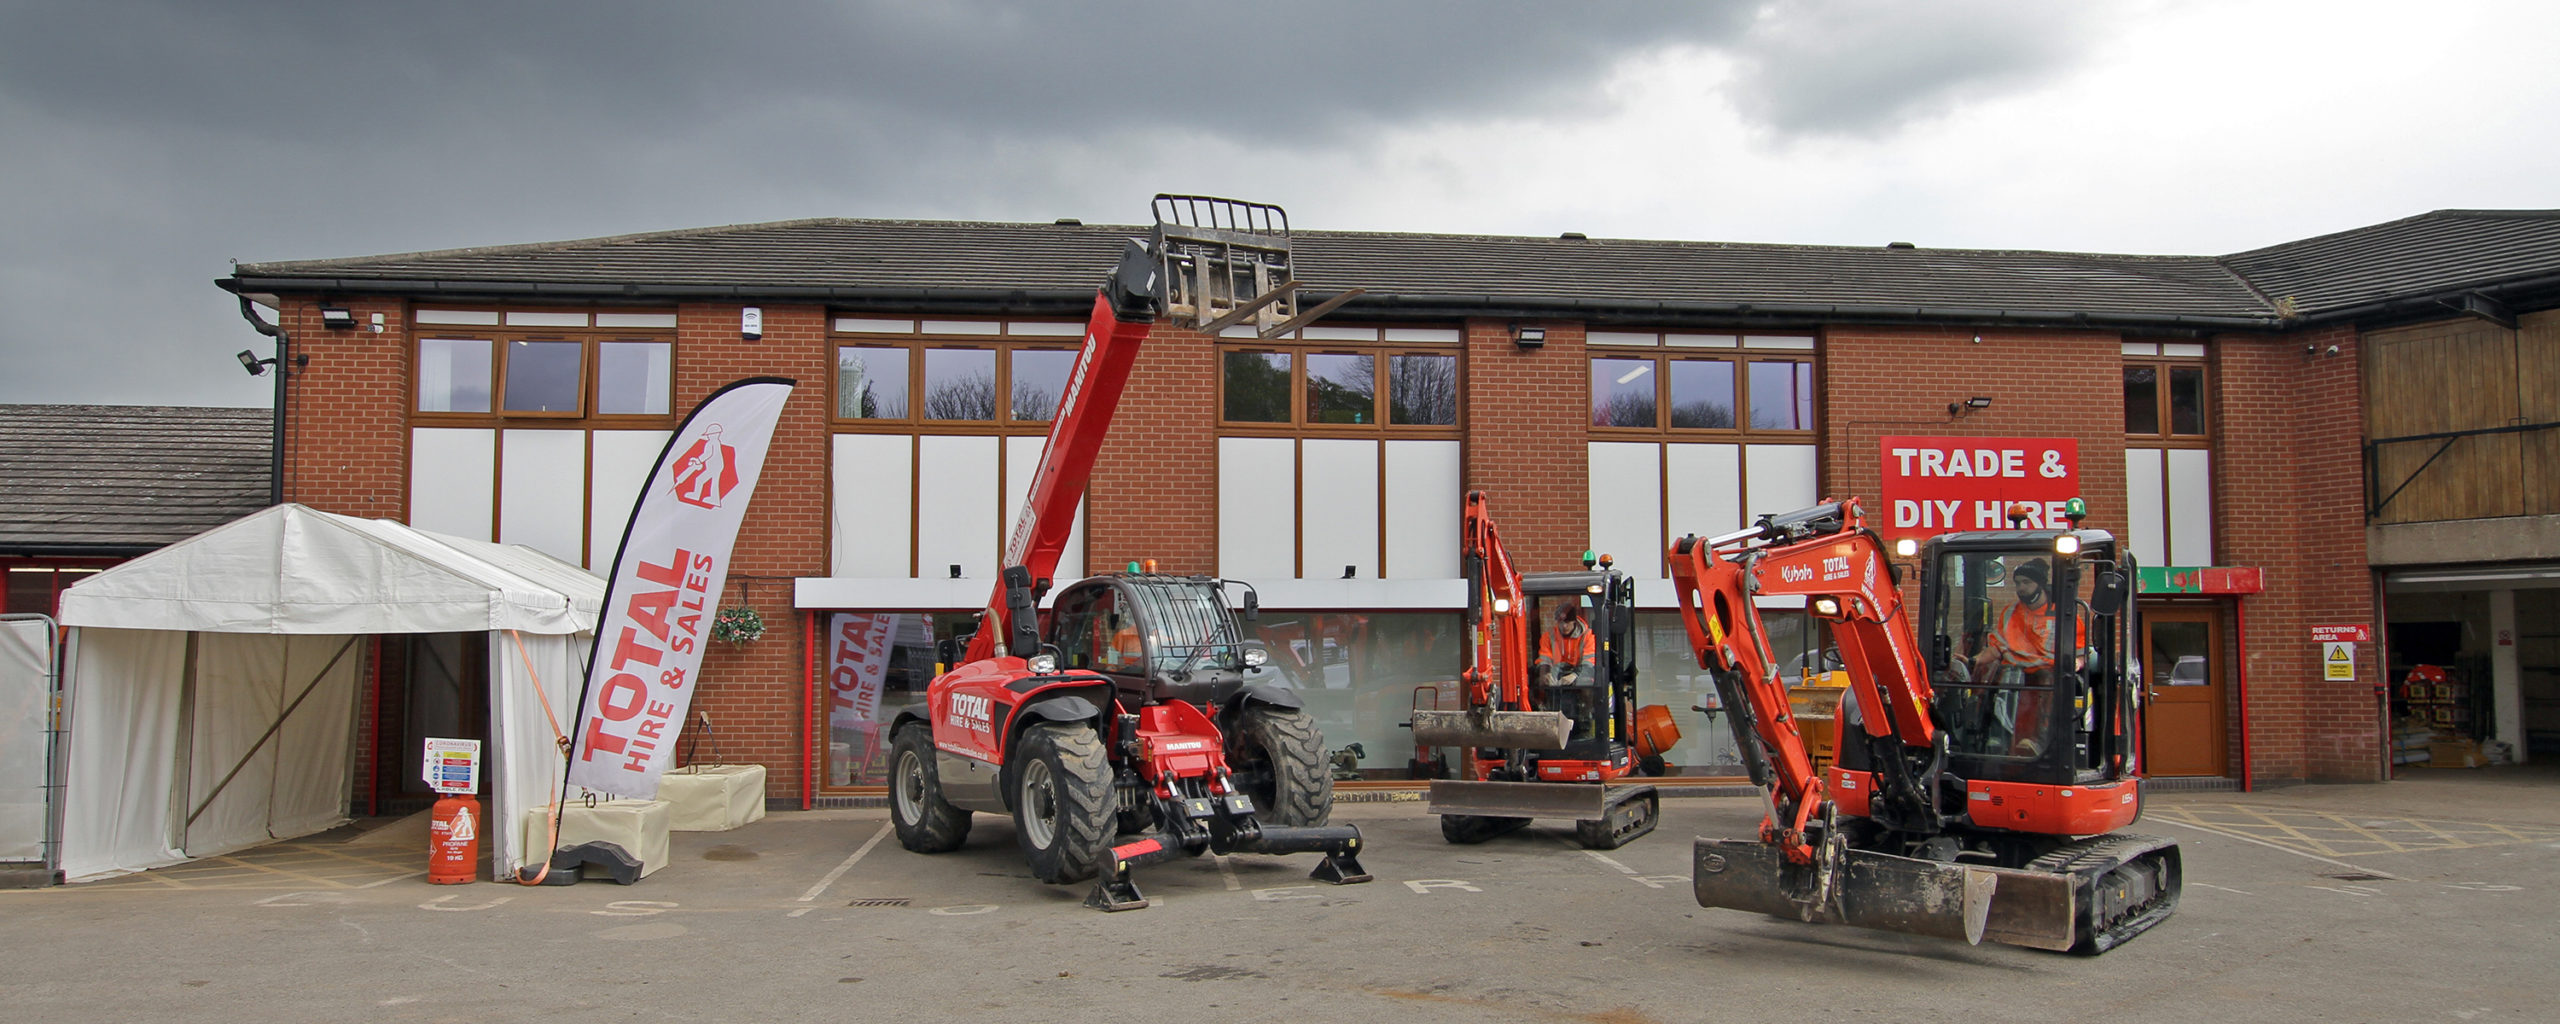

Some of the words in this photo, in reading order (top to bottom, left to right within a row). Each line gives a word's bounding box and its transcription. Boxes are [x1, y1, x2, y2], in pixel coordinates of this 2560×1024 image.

[1064, 332, 1097, 418] MANITOU
[1892, 448, 2025, 478] TRADE
[2039, 449, 2067, 479] &
[1894, 500, 1961, 529] DIY
[1975, 500, 2068, 529] HIRE
[1781, 563, 1813, 583] Kubota
[1822, 556, 1849, 573] TOTAL
[671, 553, 713, 655] SALES
[2312, 633, 2338, 641] AREA
[582, 548, 691, 762] TOTAL
[830, 613, 875, 713] TOTA
[855, 681, 877, 719] HIRE
[869, 613, 891, 657] SALE
[660, 666, 686, 689] &
[952, 692, 990, 721] TOTAL
[623, 700, 674, 773] HIRE
[950, 714, 963, 728] HIRE
[964, 717, 971, 729] &
[971, 719, 990, 734] SALES
[1166, 741, 1202, 751] MANITOU
